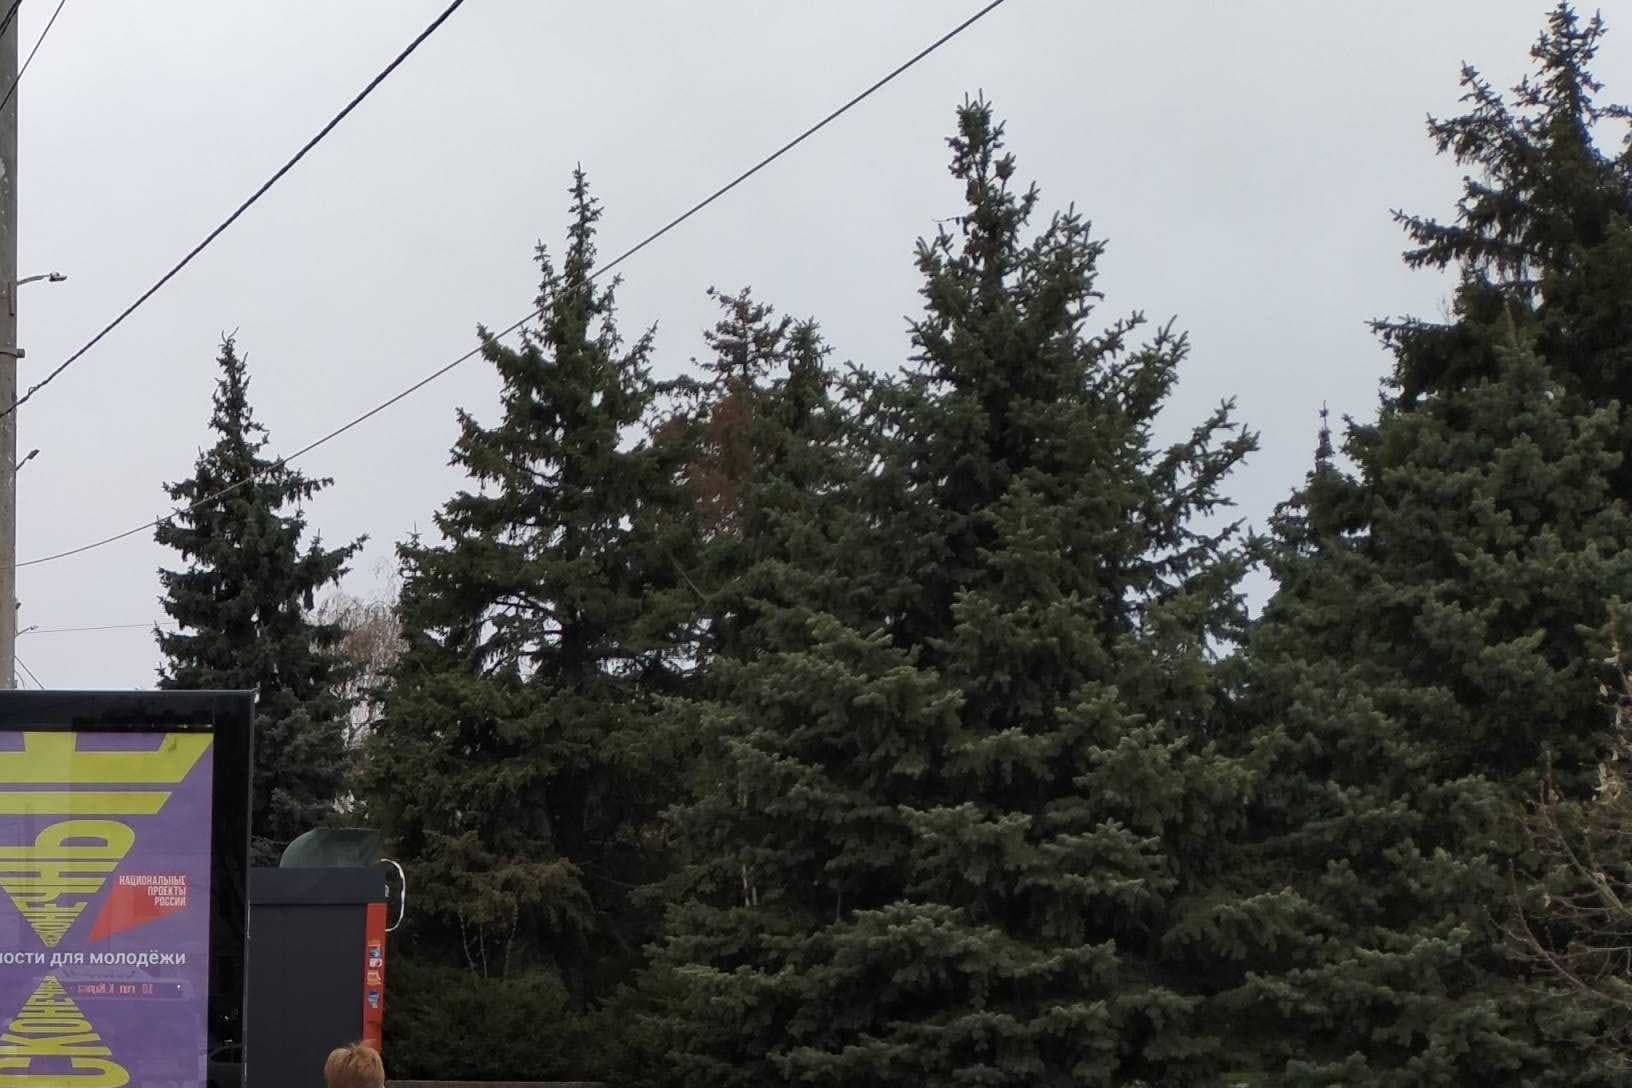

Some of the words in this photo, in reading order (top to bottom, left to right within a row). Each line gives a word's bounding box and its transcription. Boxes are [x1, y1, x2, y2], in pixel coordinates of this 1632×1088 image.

[119, 875, 187, 886] НАЦИОНАЛЬНЫЕ
[147, 886, 187, 896] ПРОЕКТЫ
[153, 896, 187, 906] РОССИИ
[50, 951, 84, 967] для
[89, 950, 186, 968] молодёжи
